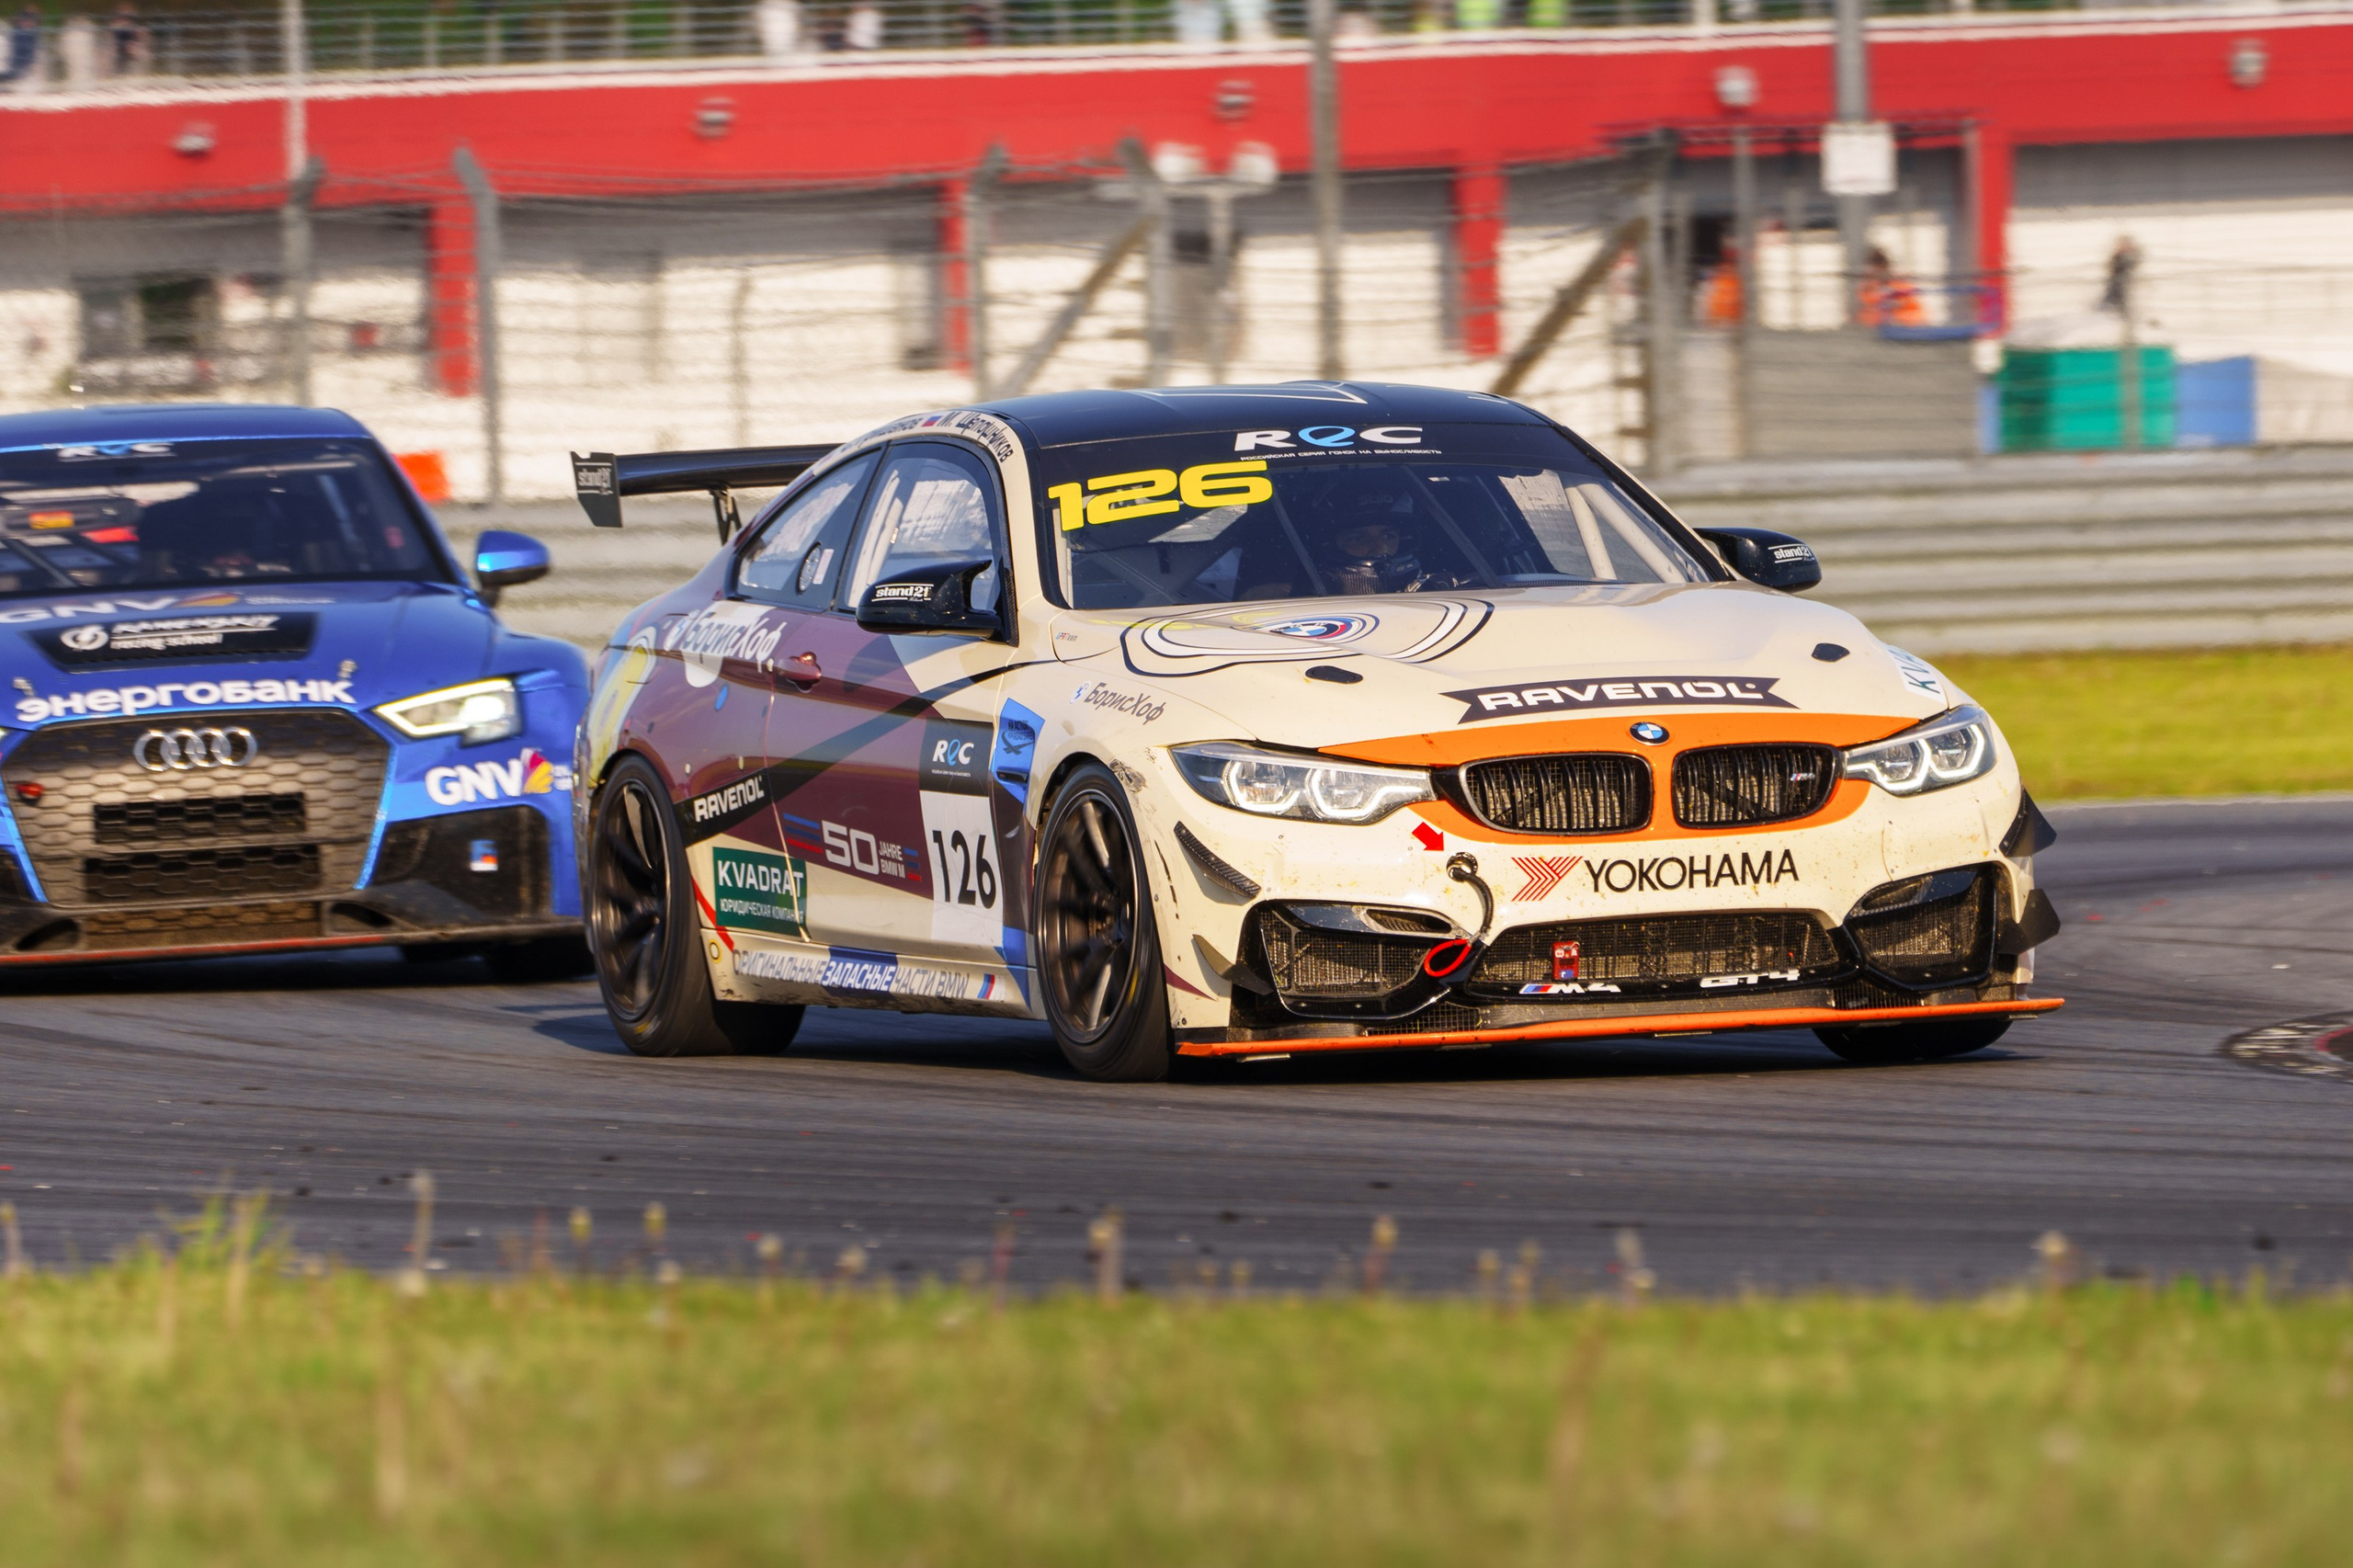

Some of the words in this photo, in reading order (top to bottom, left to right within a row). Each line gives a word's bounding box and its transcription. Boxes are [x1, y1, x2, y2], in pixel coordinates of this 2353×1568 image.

[1048, 460, 1274, 532] 126
[1773, 546, 1813, 560] stand21
[875, 585, 929, 597] stand21
[1083, 681, 1167, 726] БорисХоф
[1476, 681, 1764, 711] RAVENOL
[425, 757, 525, 806] GNV
[693, 776, 765, 823] RAVENOL
[821, 819, 880, 876] 50
[878, 840, 904, 862] JAHRE
[717, 859, 804, 898] KVADRAT
[880, 858, 898, 878] BMW
[898, 863, 906, 880] M
[931, 829, 996, 910] 126
[1584, 847, 1800, 893] YOKOHAMA
[821, 960, 897, 993] ЗАПАСНЫЕ
[894, 967, 937, 997] ЧАСТИ
[935, 971, 970, 999] BMW
[1699, 968, 1801, 989] GT4
